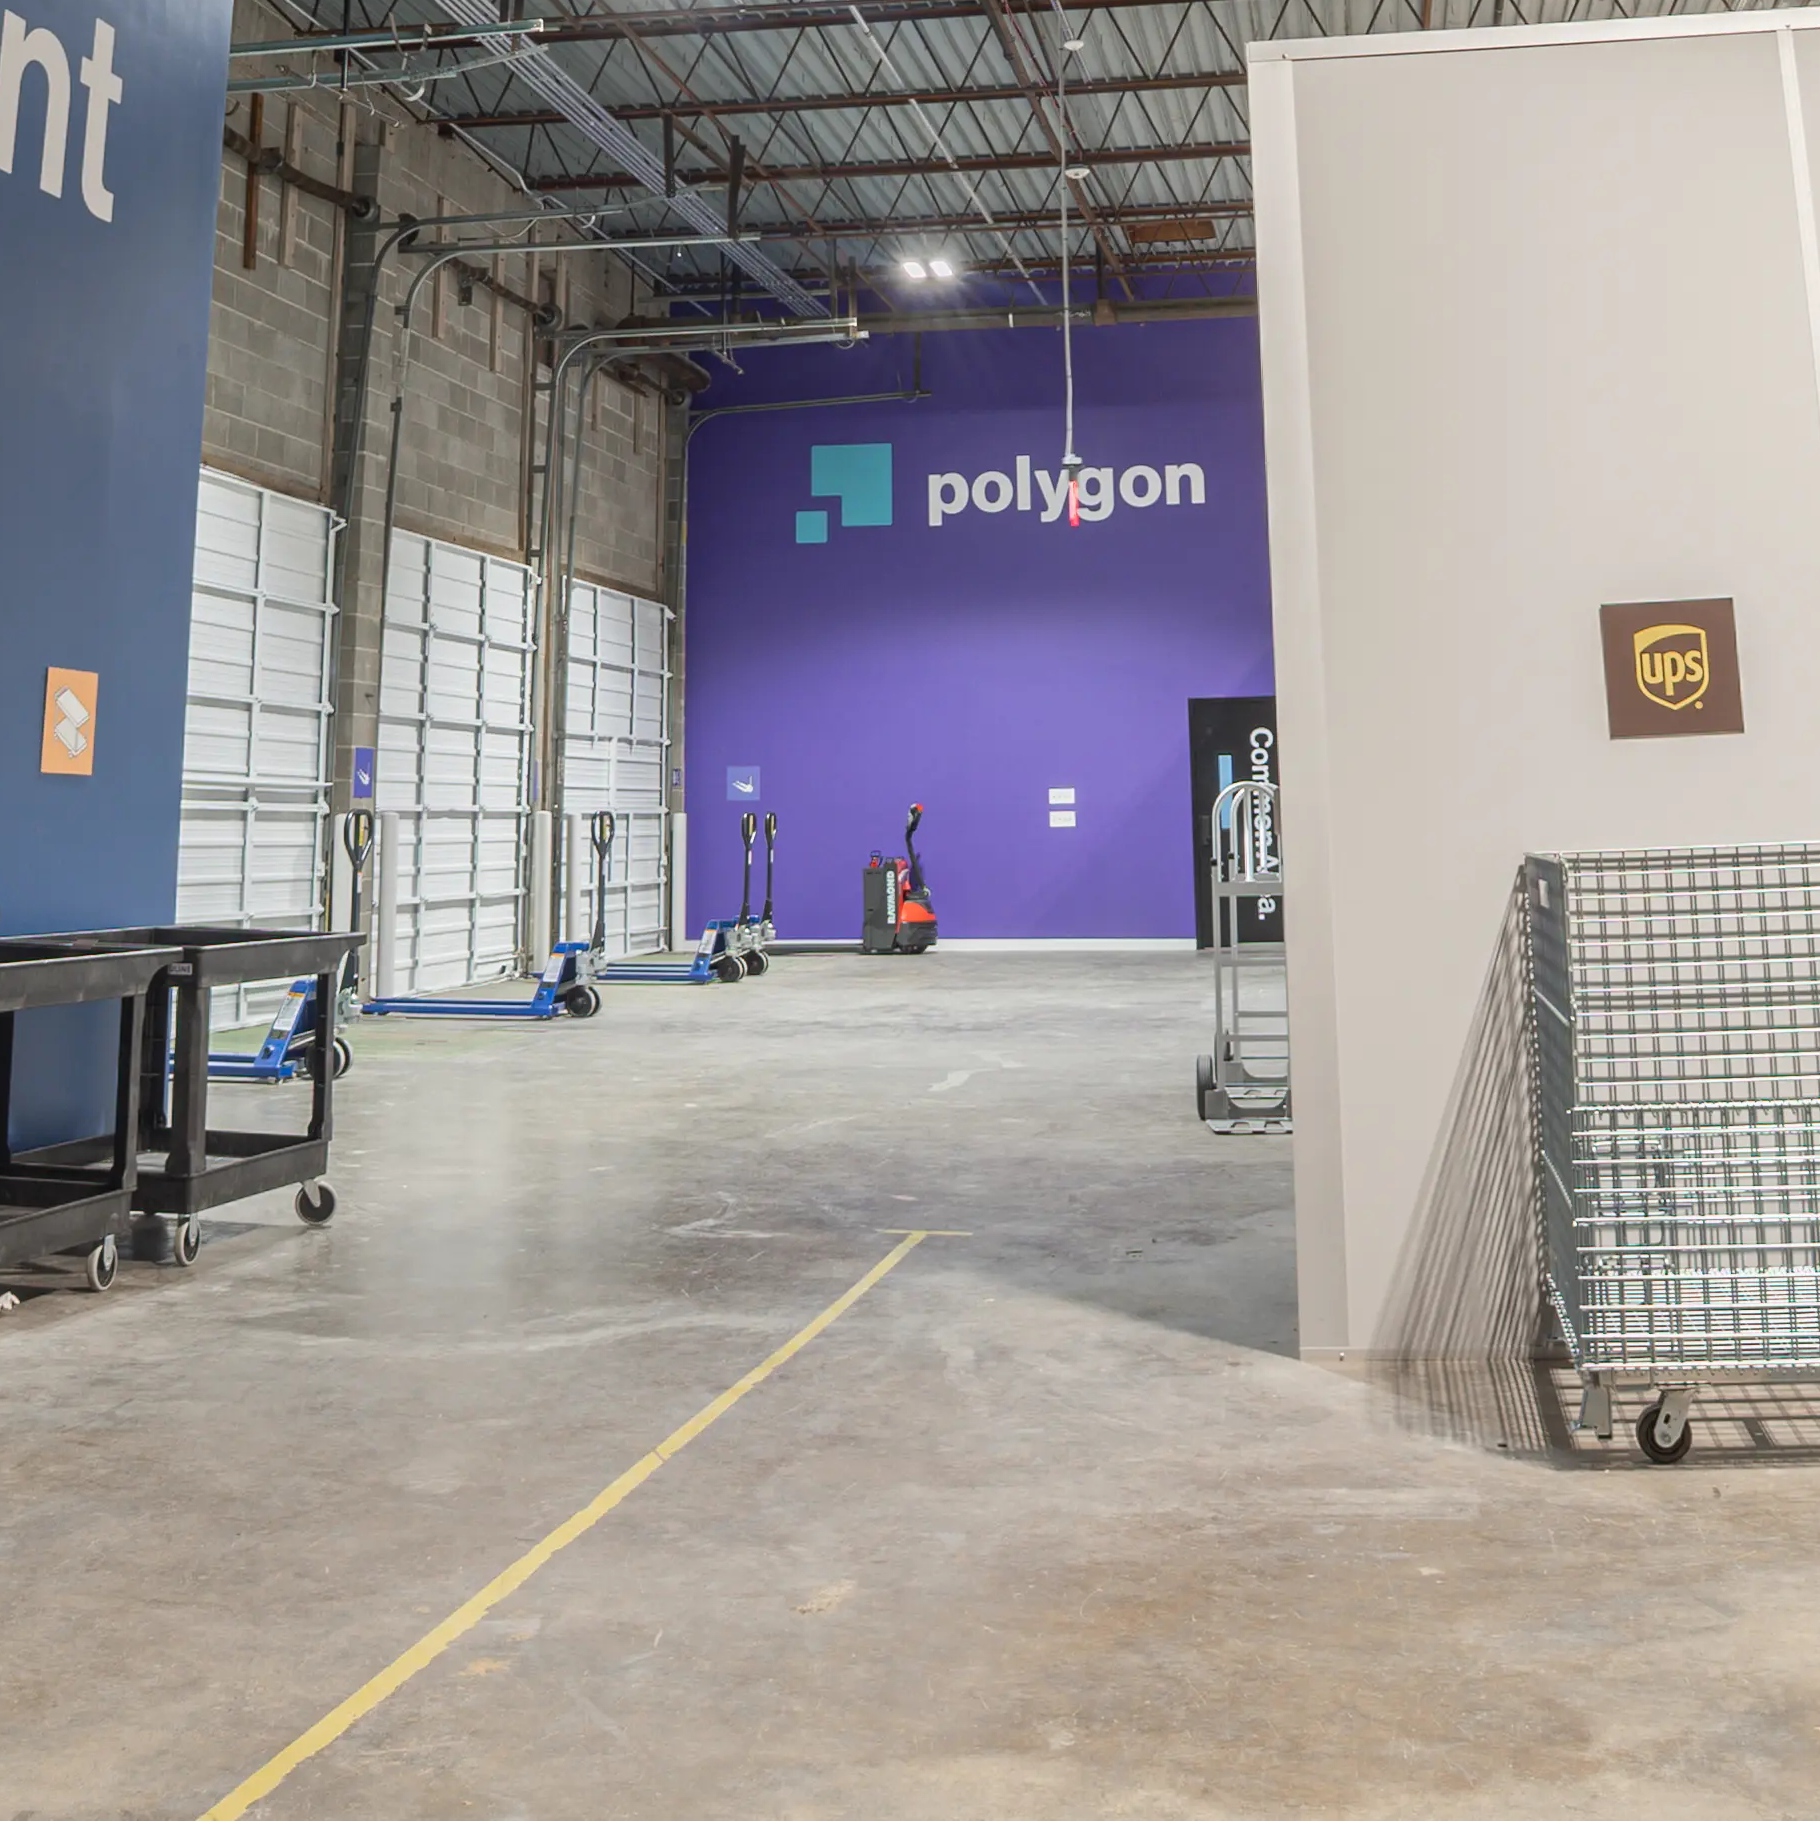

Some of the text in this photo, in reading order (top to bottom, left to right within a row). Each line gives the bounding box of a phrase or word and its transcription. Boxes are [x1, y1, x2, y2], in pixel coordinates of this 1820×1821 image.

[929, 455, 1205, 526] polygon
[1641, 650, 1704, 696] ups
[886, 870, 896, 924] RAYMOND
